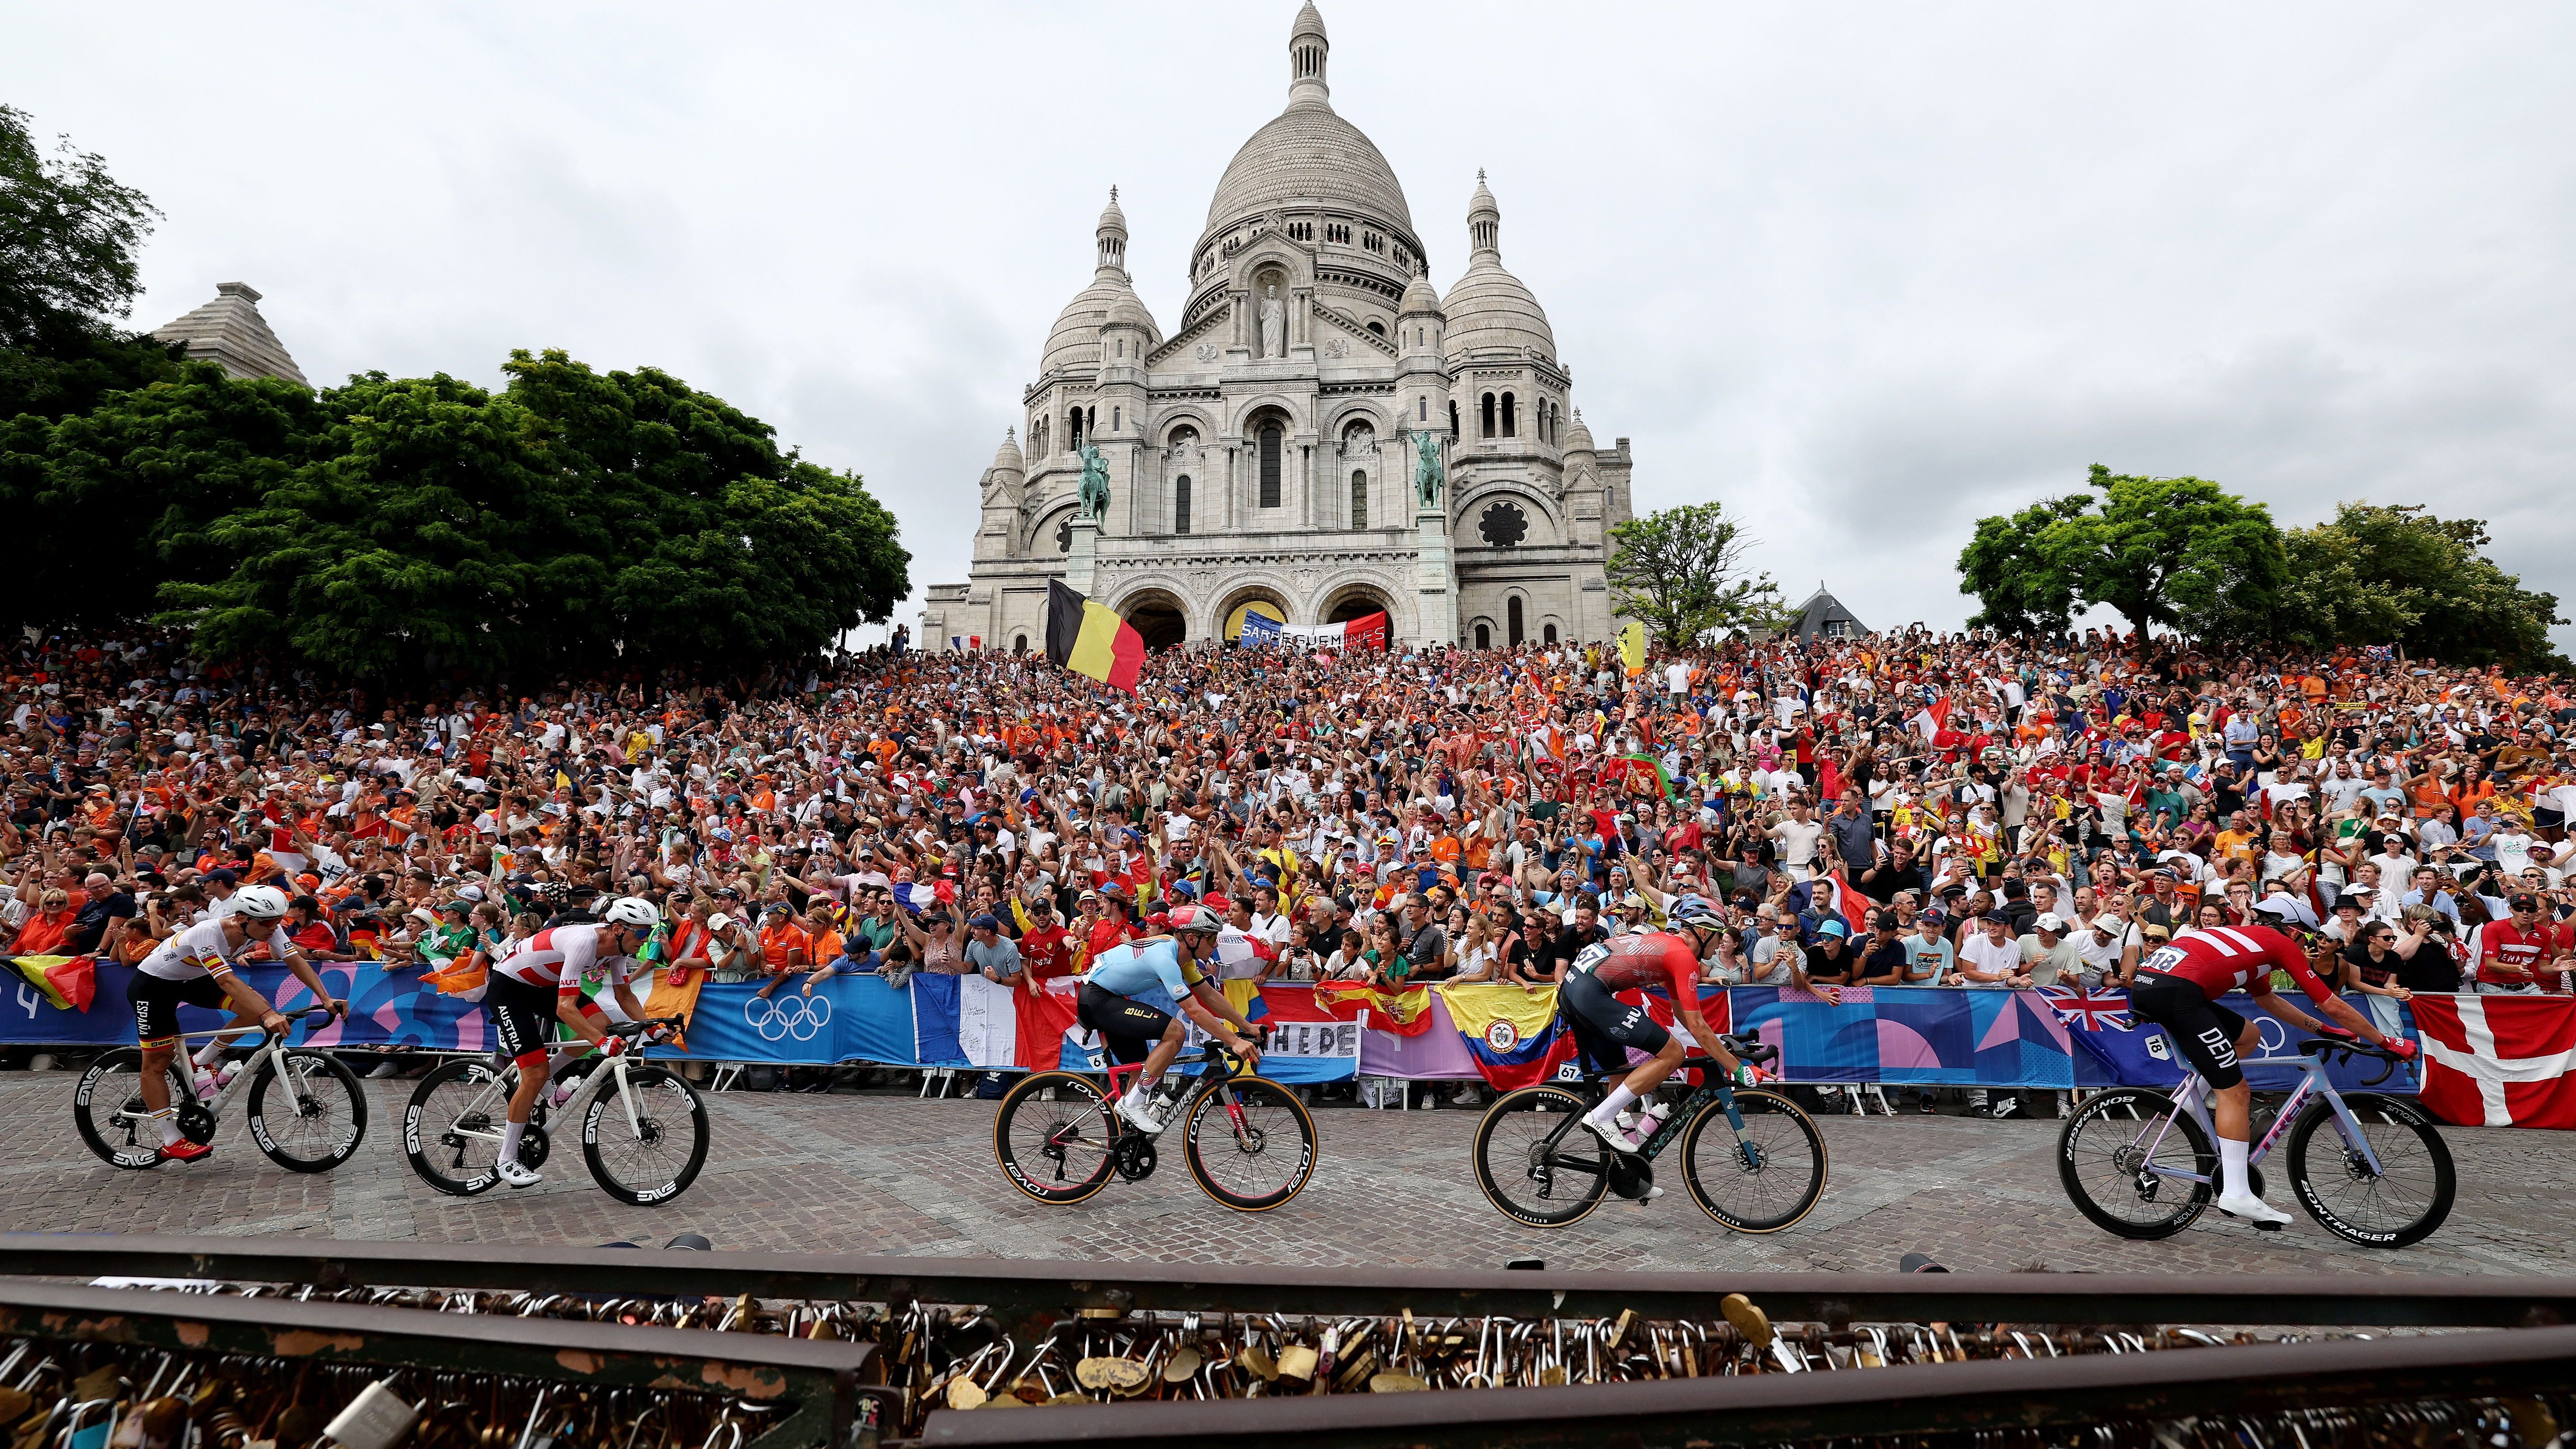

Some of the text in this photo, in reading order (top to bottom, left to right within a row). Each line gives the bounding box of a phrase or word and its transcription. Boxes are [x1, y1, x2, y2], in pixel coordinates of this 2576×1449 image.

[1260, 366, 1312, 374] SACRATISSIMUM
[639, 905, 650, 918] MET
[1178, 920, 1212, 929] SPECIALIZED
[163, 952, 178, 961] ESPAÑA
[1577, 949, 1600, 965] 67
[2134, 974, 2155, 985] ENMARK
[137, 1000, 149, 1035] ESPAÑA
[498, 1006, 522, 1052] AUSTRIA
[2149, 1039, 2162, 1053] 18
[2198, 1027, 2237, 1068] DEN
[220, 1052, 261, 1100] COLNAGO
[1561, 1067, 1576, 1079] 67
[1744, 1067, 1755, 1087] HUN
[77, 1066, 105, 1106] ENVE
[556, 1067, 602, 1119] COLNAGO
[664, 1077, 696, 1112] ENVE
[1067, 1081, 1110, 1114] roval
[1539, 1093, 1572, 1104] RESERVE
[1767, 1098, 1800, 1118] RESERVE
[1996, 1097, 2016, 1112] NIKE
[586, 1101, 605, 1144] ENVE
[1118, 1103, 1139, 1125] SPECIALIZED
[1189, 1095, 1213, 1144] roval
[2258, 1083, 2314, 1152] TREK
[2386, 1105, 2421, 1125] AEOLUS
[251, 1116, 276, 1152] ENVE
[406, 1105, 422, 1154] ENVE
[1591, 1121, 1613, 1141] nimbl
[2067, 1096, 2136, 1161] BONTRAGER
[334, 1123, 358, 1159] ENVE
[113, 1151, 156, 1166] ENVE
[1288, 1142, 1311, 1194] roval
[637, 1180, 677, 1201] ENVE
[1005, 1162, 1049, 1196] roval
[1514, 1211, 1547, 1223] RESERVE
[1709, 1206, 1740, 1226] RESERVE
[2173, 1202, 2198, 1226] AEOLUS
[2301, 1179, 2397, 1243] BONTRAGER
